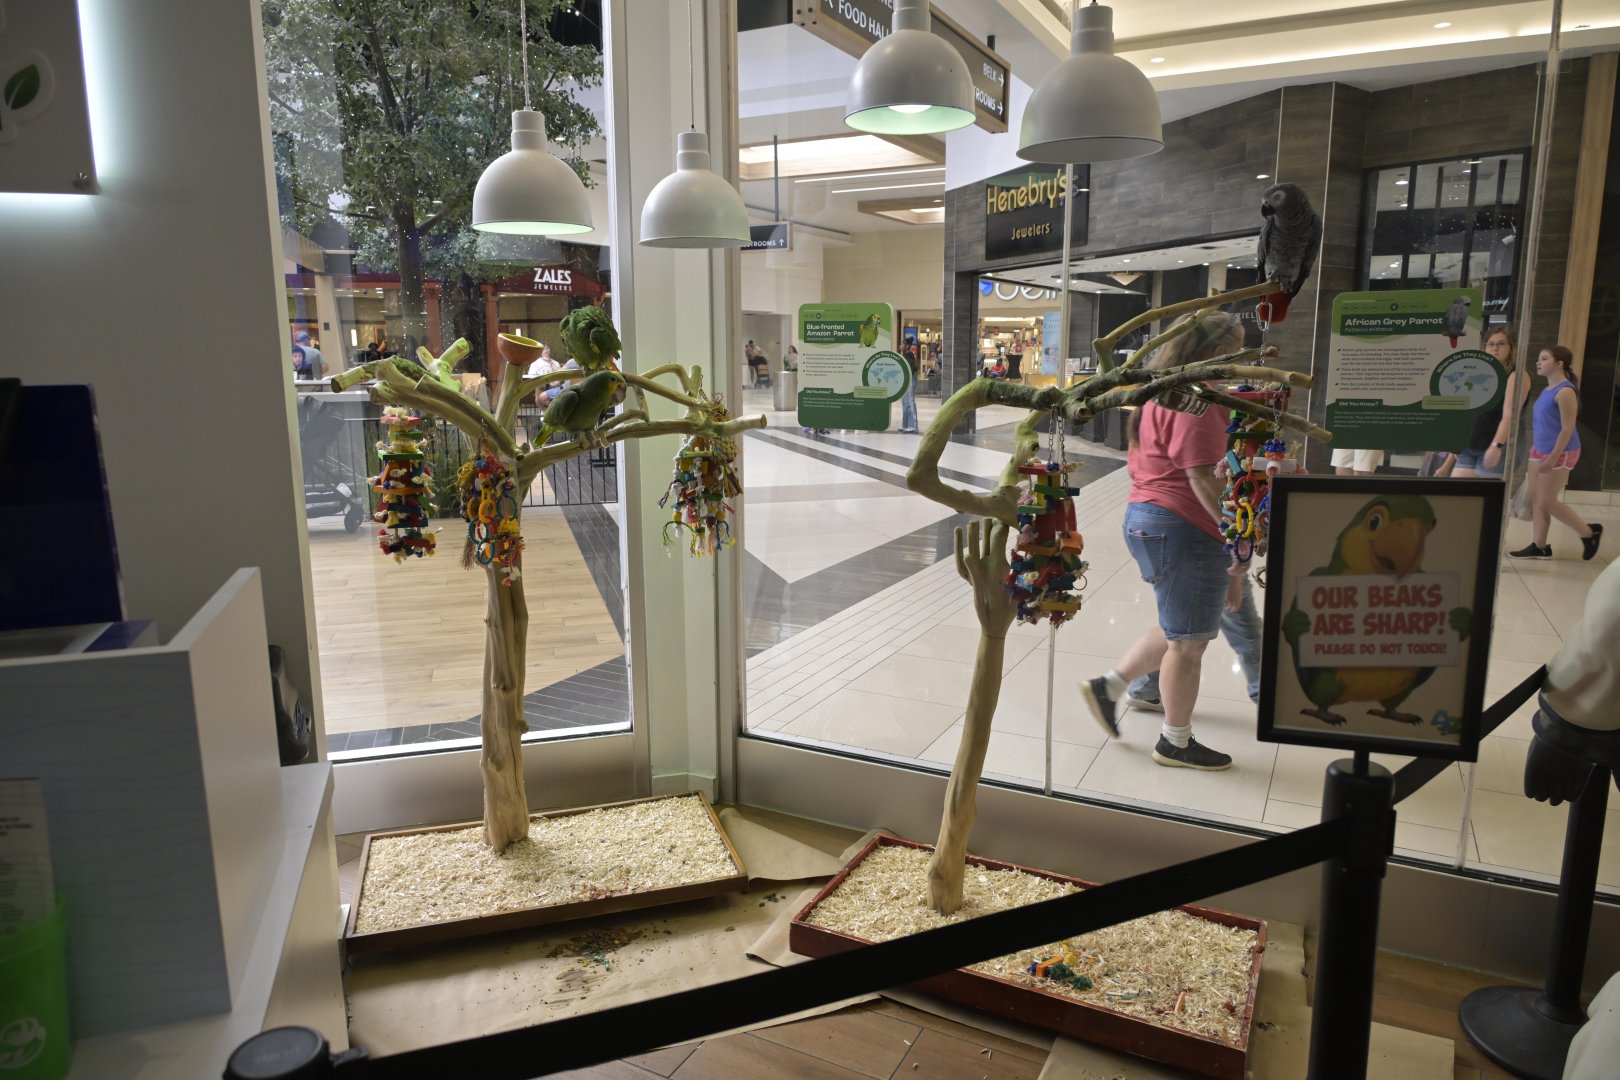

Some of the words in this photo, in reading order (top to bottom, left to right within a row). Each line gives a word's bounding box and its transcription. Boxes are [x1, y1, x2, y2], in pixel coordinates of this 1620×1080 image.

[839, 0, 866, 28] FOOD
[983, 62, 997, 82] BELK
[987, 169, 1068, 215] Henebry's
[1011, 223, 1050, 240] Jewelers
[533, 267, 572, 285] ZALES
[534, 283, 572, 291] JEWELERS
[1345, 318, 1381, 326] African
[1383, 318, 1407, 327] Grey
[1409, 317, 1443, 325] Parrot
[1311, 586, 1358, 609] OUR
[1367, 583, 1443, 608] BEAKS
[1313, 613, 1355, 636] ARE
[1362, 611, 1446, 635] SHARP!
[1314, 643, 1355, 655] PLEASE
[1360, 643, 1376, 655] DO
[1380, 643, 1402, 655] NOT
[1407, 642, 1447, 654] TOUCH!
